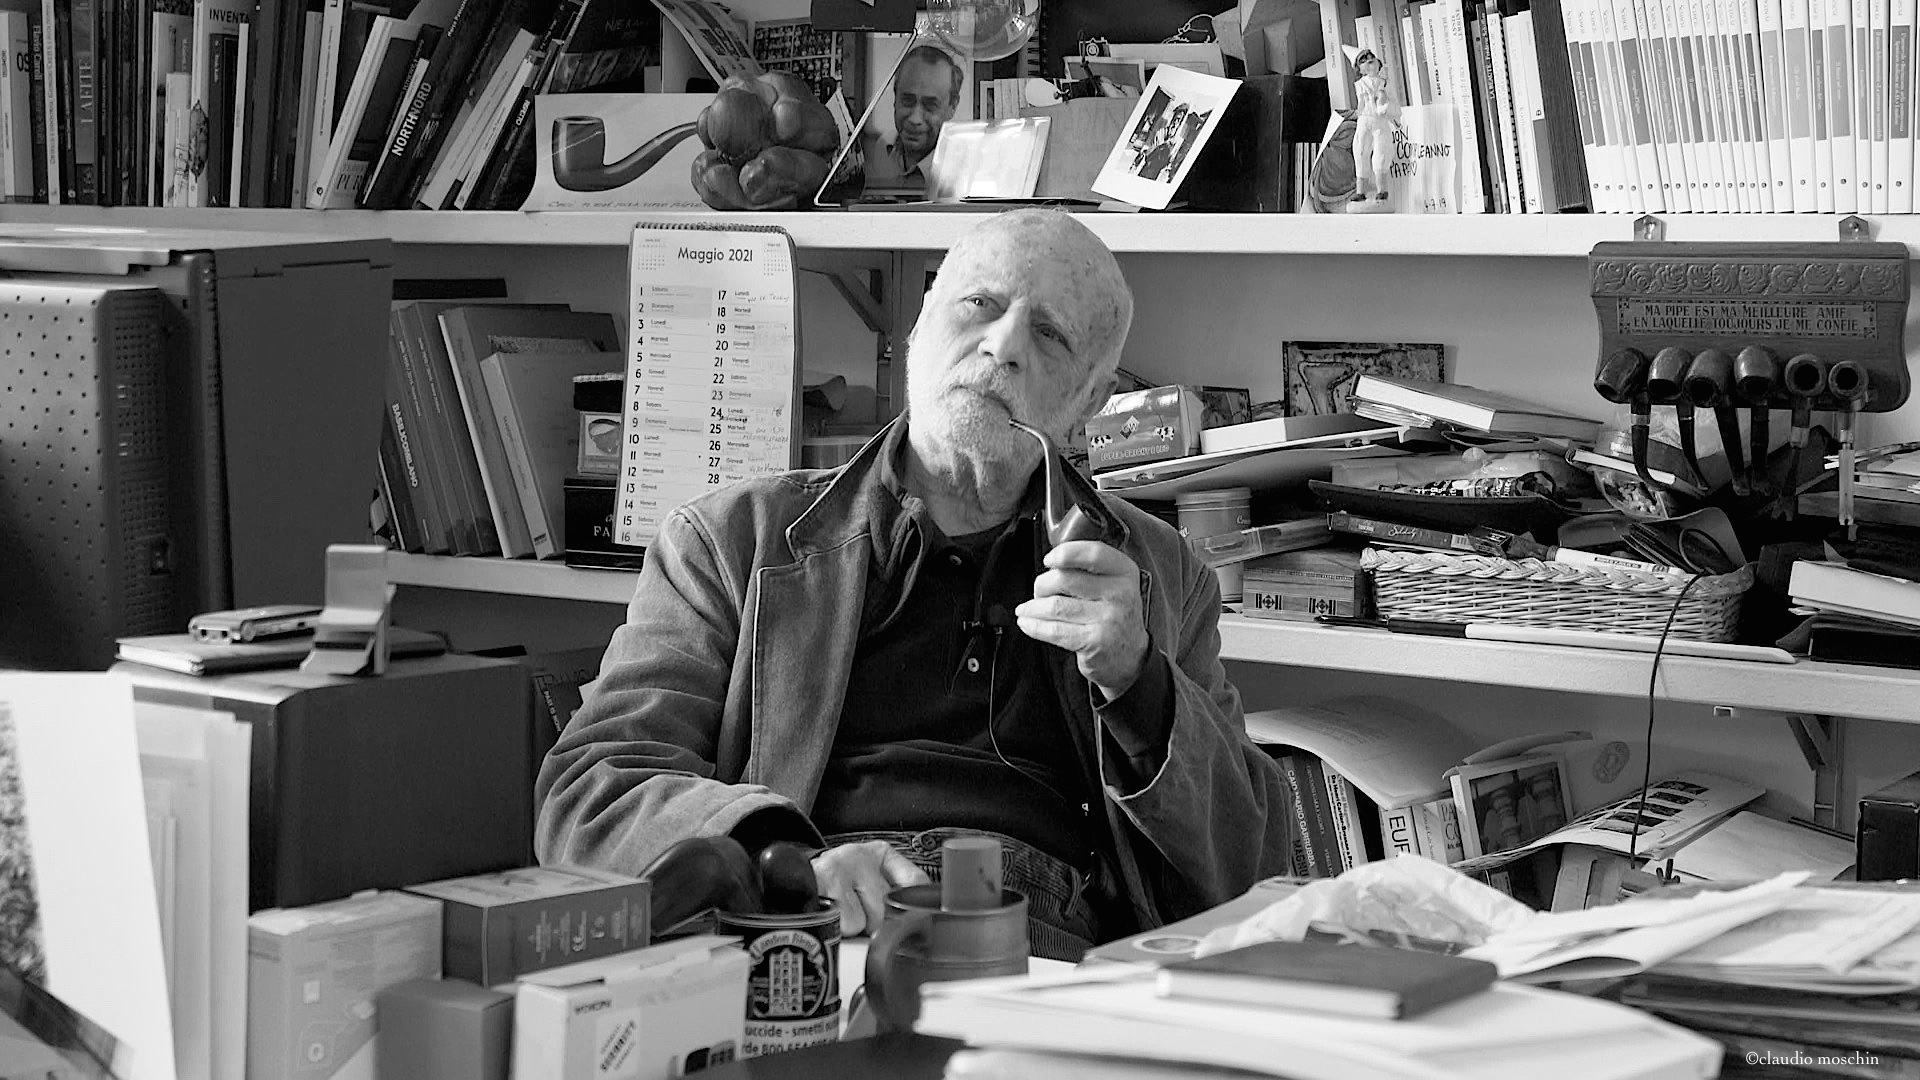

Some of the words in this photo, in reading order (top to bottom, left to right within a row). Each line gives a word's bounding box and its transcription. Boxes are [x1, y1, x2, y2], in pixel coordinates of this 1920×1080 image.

[678, 247, 725, 263] Maggio
[729, 249, 753, 262] 2021
[718, 290, 727, 300] 17
[638, 303, 644, 312] 2
[717, 307, 726, 317] 18
[1645, 305, 1661, 317] MA
[1665, 305, 1690, 317] PIPE
[1695, 306, 1716, 317] EST
[1720, 306, 1737, 317] MA
[1742, 305, 1809, 318] MEILLEURE
[1817, 306, 1847, 318] AMIE
[638, 319, 644, 329] 3
[716, 324, 726, 334] 19
[1634, 317, 1649, 328] EN
[1652, 317, 1708, 329] LAQUELLE
[1711, 318, 1772, 330] TOUJOURS
[1775, 319, 1790, 330] JE
[1795, 319, 1812, 330] ME
[1816, 320, 1859, 331] CONFIE
[637, 336, 643, 346] 4
[715, 341, 728, 351] 20
[636, 353, 643, 362] 5
[714, 357, 723, 367] 21
[635, 368, 641, 378] 6
[713, 374, 724, 384] 22
[634, 385, 640, 395] 7
[712, 391, 723, 401] 23
[633, 401, 639, 411] 8
[711, 407, 722, 417] 24
[632, 418, 639, 427] 9
[710, 423, 722, 434] 25
[629, 434, 640, 444] 10
[709, 440, 721, 450] 26
[630, 451, 636, 460] 11
[708, 457, 720, 467] 27
[628, 467, 637, 476] 12
[708, 474, 720, 484] 28
[626, 483, 635, 493] 13
[625, 500, 633, 509] 14
[623, 516, 632, 525] 15
[621, 532, 630, 542] 16
[1287, 770, 1298, 790] CAIO
[1292, 792, 1304, 819] MARIO
[1336, 802, 1350, 849] Cartier-Bresson
[1298, 821, 1315, 867] GARRUBBA
